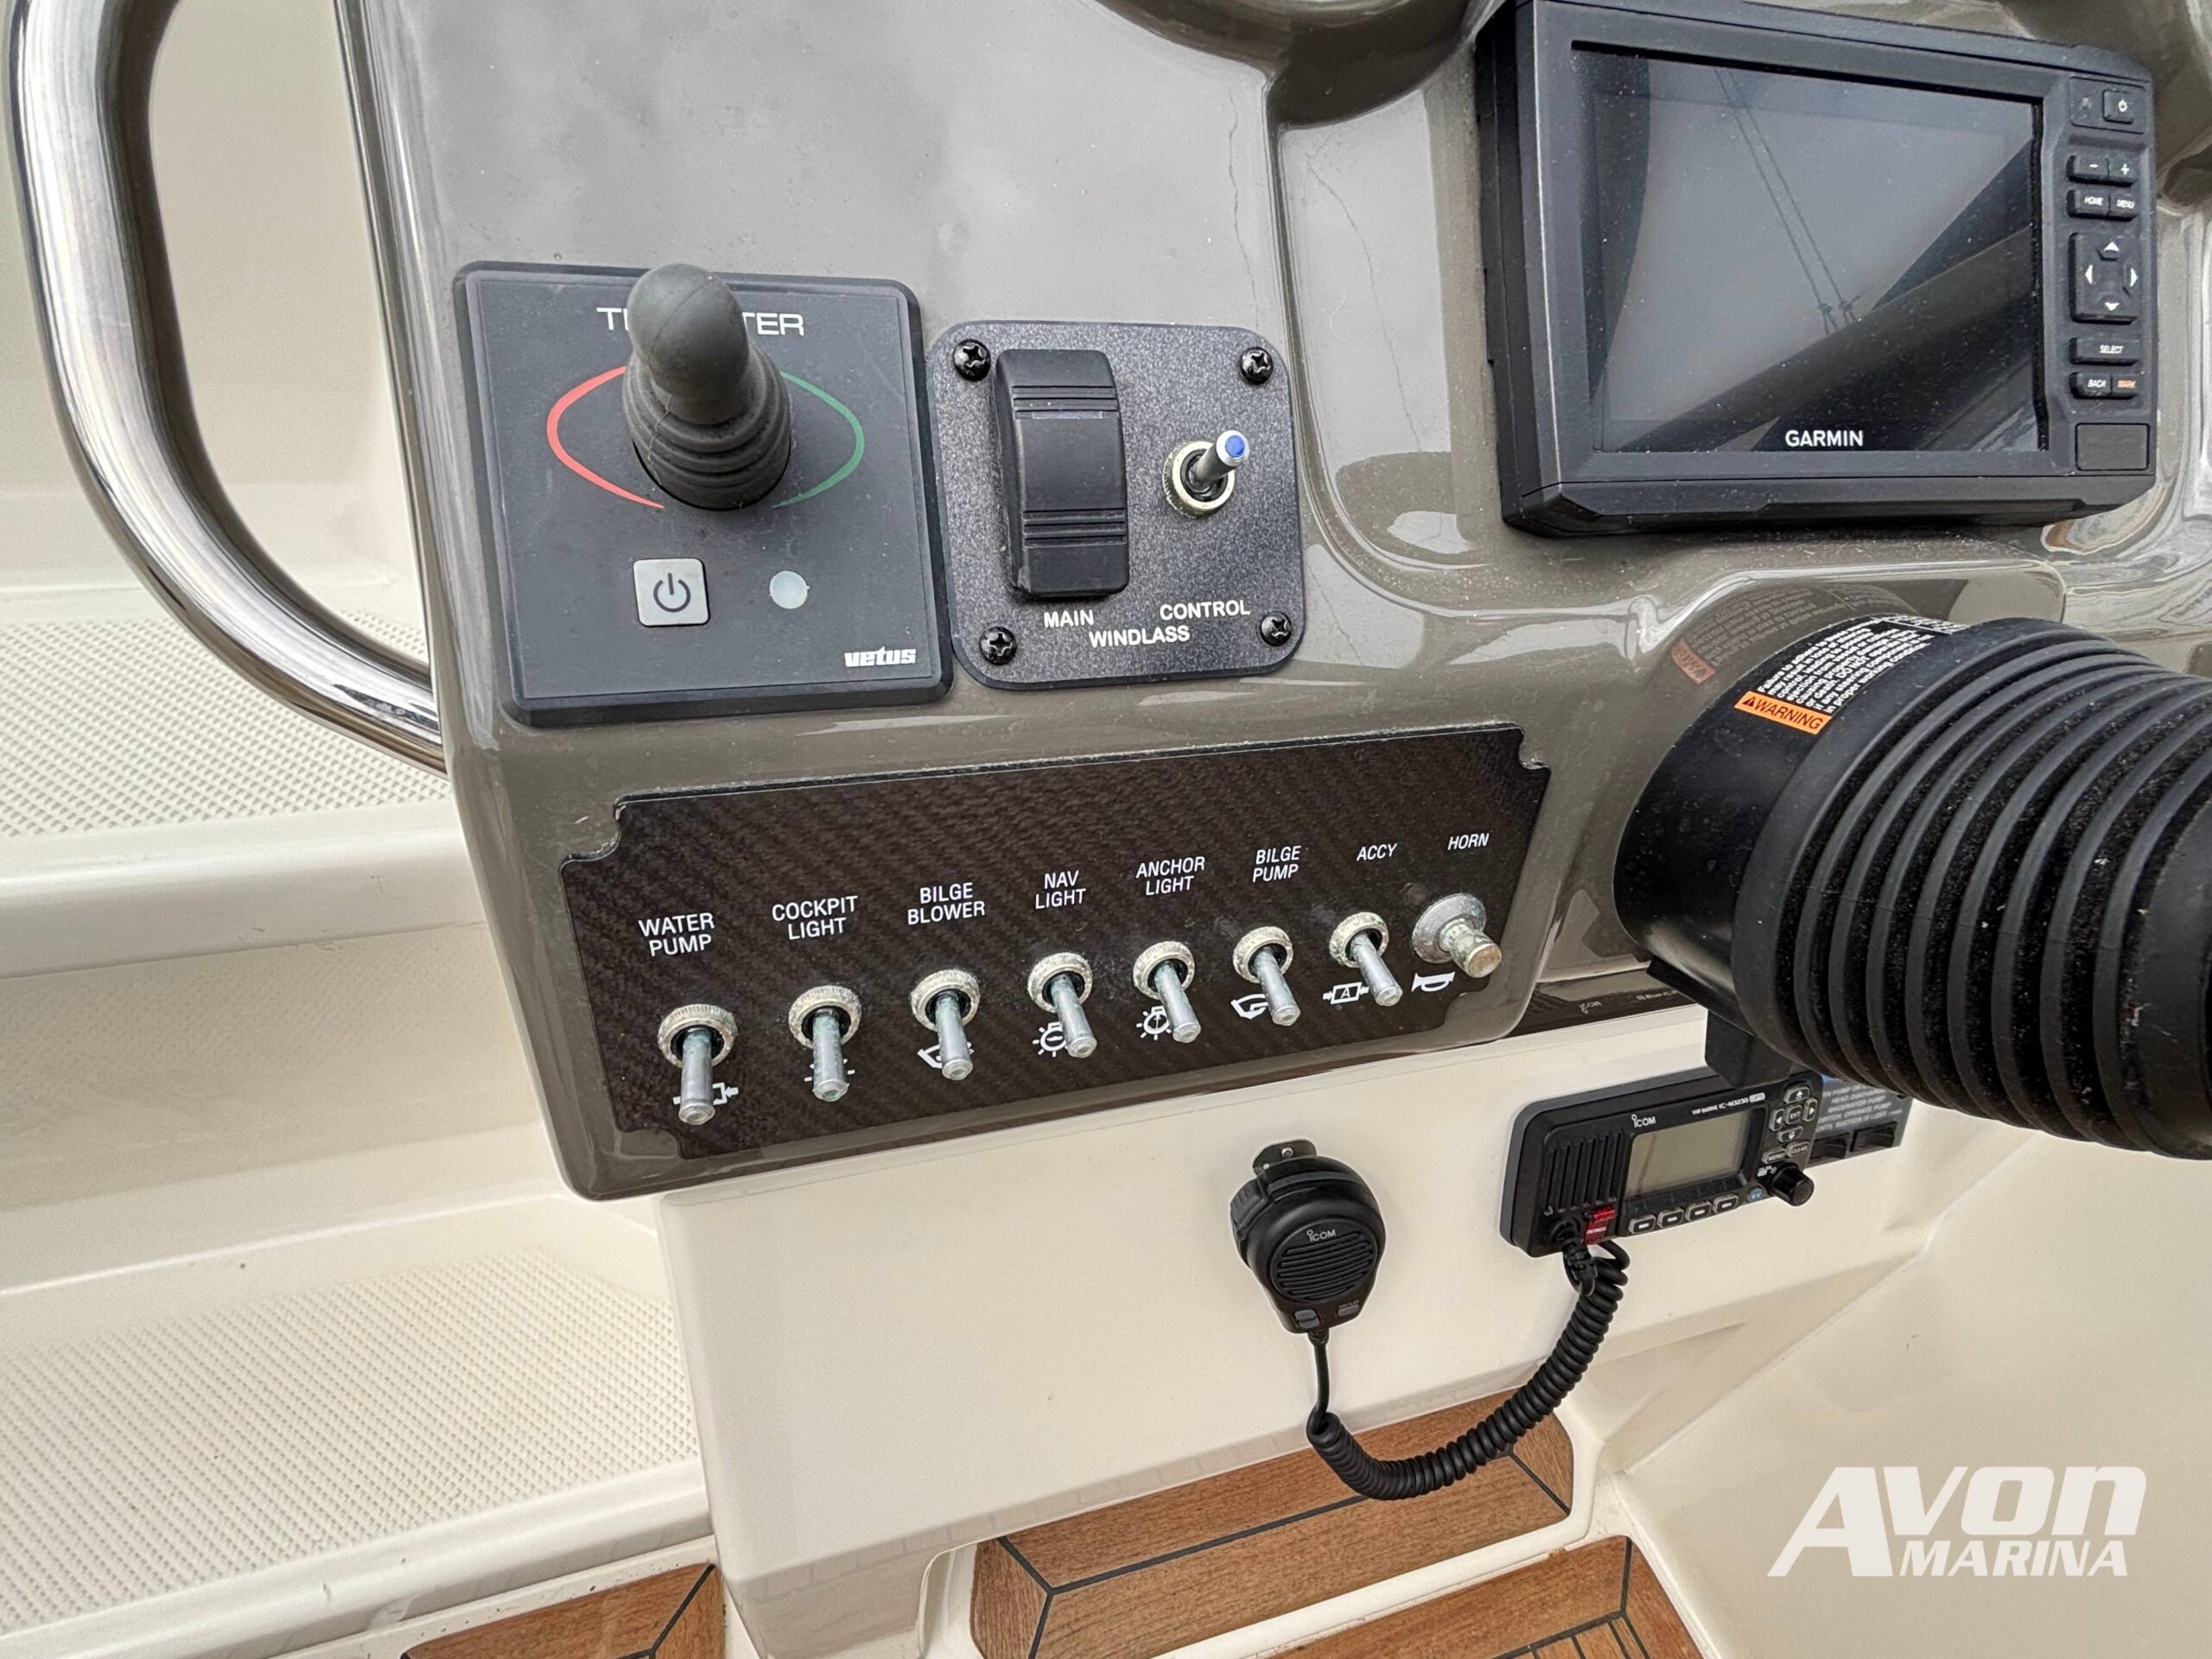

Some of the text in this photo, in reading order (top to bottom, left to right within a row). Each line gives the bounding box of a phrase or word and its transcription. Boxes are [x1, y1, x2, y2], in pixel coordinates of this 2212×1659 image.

[2100, 345, 2123, 354] SELECT
[2088, 378, 2107, 388] BACK
[1785, 429, 1863, 447] GARMIN
[1043, 609, 1094, 628] MAIN
[1160, 600, 1250, 621] CONTROL
[1089, 625, 1190, 648] WINDLASS
[844, 645, 916, 667] vetus
[1757, 671, 1785, 692] Failure
[1768, 681, 1786, 695] may
[1783, 664, 1807, 681] result
[1777, 674, 1808, 698] control,
[1802, 653, 1835, 674] leading
[1786, 675, 1818, 701] ejection
[1813, 662, 1835, 676] from
[1832, 645, 1859, 662] vessel
[1796, 678, 1828, 704] causing
[1823, 655, 1859, 679] property
[1805, 697, 1816, 707] or
[1814, 679, 1840, 698] death.
[1835, 667, 1853, 678] DO
[1848, 655, 1871, 669] NOT
[1833, 683, 1860, 706] proper
[1858, 662, 1894, 683] working
[1821, 691, 1839, 704] any
[1835, 667, 1871, 691] steering
[1754, 697, 1823, 729] WARNING
[1357, 843, 1397, 861] ACCY
[1447, 833, 1490, 851] HORN
[1255, 845, 1301, 866] BILGE
[1136, 856, 1205, 880] ANCHOR
[1252, 864, 1299, 883] PUMP
[1044, 871, 1079, 889] NAV
[1145, 876, 1195, 896] LIGHT
[919, 882, 974, 904] BILGE
[1035, 888, 1086, 910] LIGHT
[772, 895, 858, 922] COCKPIT
[907, 900, 985, 925] BLOWER
[638, 912, 715, 937] WATER
[788, 917, 847, 940] LIGHT
[649, 934, 712, 957] PUMP
